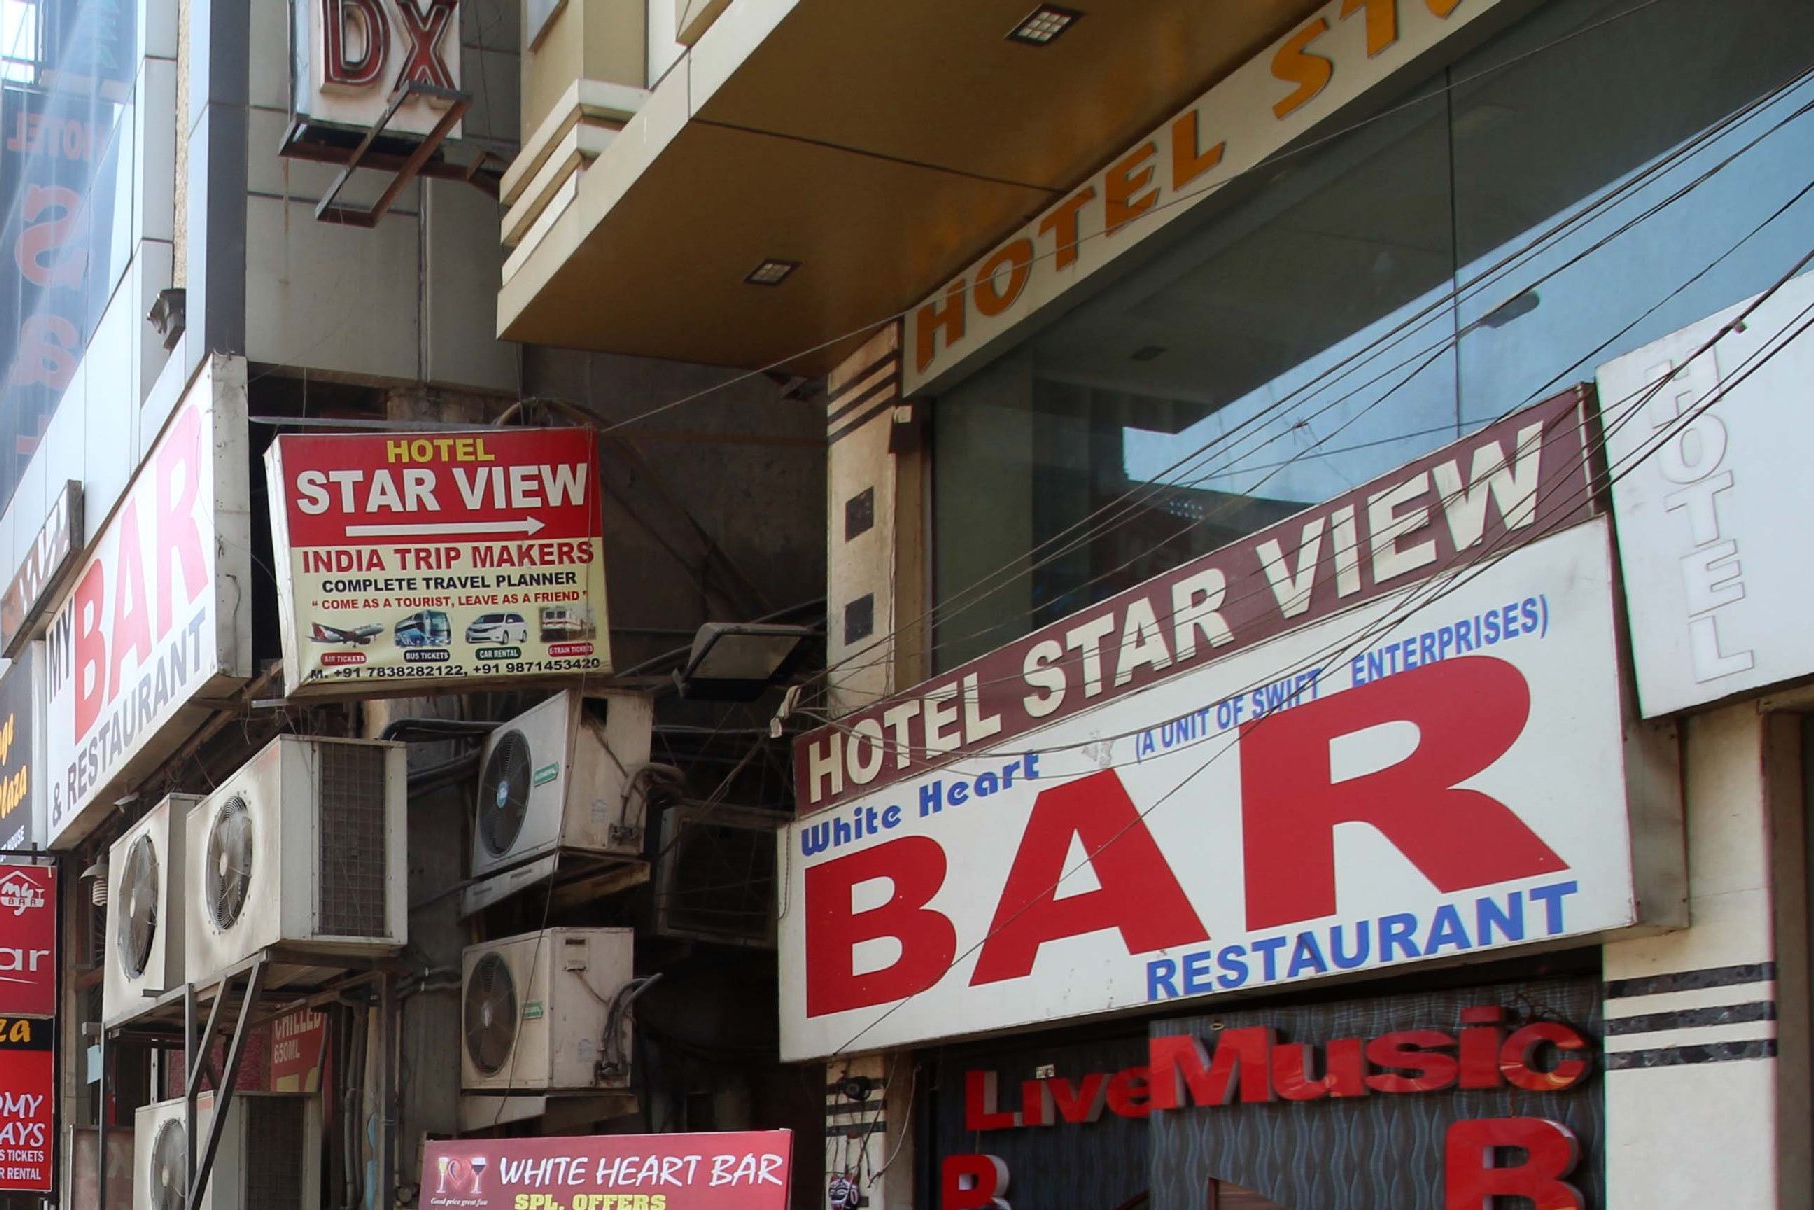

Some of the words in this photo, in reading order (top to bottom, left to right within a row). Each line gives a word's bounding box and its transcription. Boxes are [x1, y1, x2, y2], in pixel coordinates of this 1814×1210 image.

[917, 110, 1225, 375] HOTEL
[387, 439, 495, 463] HOTEL
[296, 468, 441, 515] STAR
[452, 463, 588, 512] VIEW
[1644, 343, 1754, 684] HOTEL
[74, 404, 210, 745] BAR
[303, 549, 385, 573] INDIA
[394, 546, 462, 572] TRIP
[473, 542, 594, 567] MAKERS
[322, 578, 418, 593] COMPLETE
[422, 575, 491, 590] TRAVEL
[496, 571, 577, 587] PLANNER
[322, 599, 358, 610] COME
[362, 598, 379, 609] AS
[383, 598, 392, 608] A
[396, 596, 455, 609] TOURIST,
[458, 595, 498, 606] LEAVE
[501, 594, 518, 605] AS
[522, 593, 531, 604] A
[534, 591, 579, 603] FRIEND
[808, 672, 1002, 803] HOTEL
[1021, 567, 1235, 718] STAR
[1256, 421, 1544, 619] VIEW
[48, 599, 73, 705] MY
[310, 669, 327, 679] M.
[335, 667, 363, 678] +91
[367, 665, 468, 678] 7838282122,
[473, 663, 500, 674] +91
[506, 658, 601, 673] 9871453420
[405, 652, 419, 660] BUS
[420, 651, 449, 660] TICKETS
[479, 650, 493, 658] CAR
[494, 649, 519, 658] RENTAL
[1135, 728, 1155, 763] (A
[1161, 709, 1210, 748] UNIT
[1217, 695, 1245, 730] OF
[1251, 667, 1322, 719] SWIFT
[1351, 594, 1548, 689] ENTERPRISES)
[51, 782, 64, 820] &
[67, 610, 207, 808] RESTAURANT
[801, 805, 902, 857] White
[919, 751, 1039, 818] Heart
[804, 654, 1573, 1020] BAR
[1146, 880, 1581, 1002] RESTAURANT
[965, 1063, 1158, 1131] Live
[1148, 1005, 1587, 1110] Music
[7, 1150, 44, 1163] TICKETS
[7, 1168, 41, 1180] RENTAL
[499, 1156, 588, 1187] WHITE
[596, 1155, 702, 1187] HEART
[709, 1153, 783, 1187] BAR
[514, 1194, 565, 1210] SPL.
